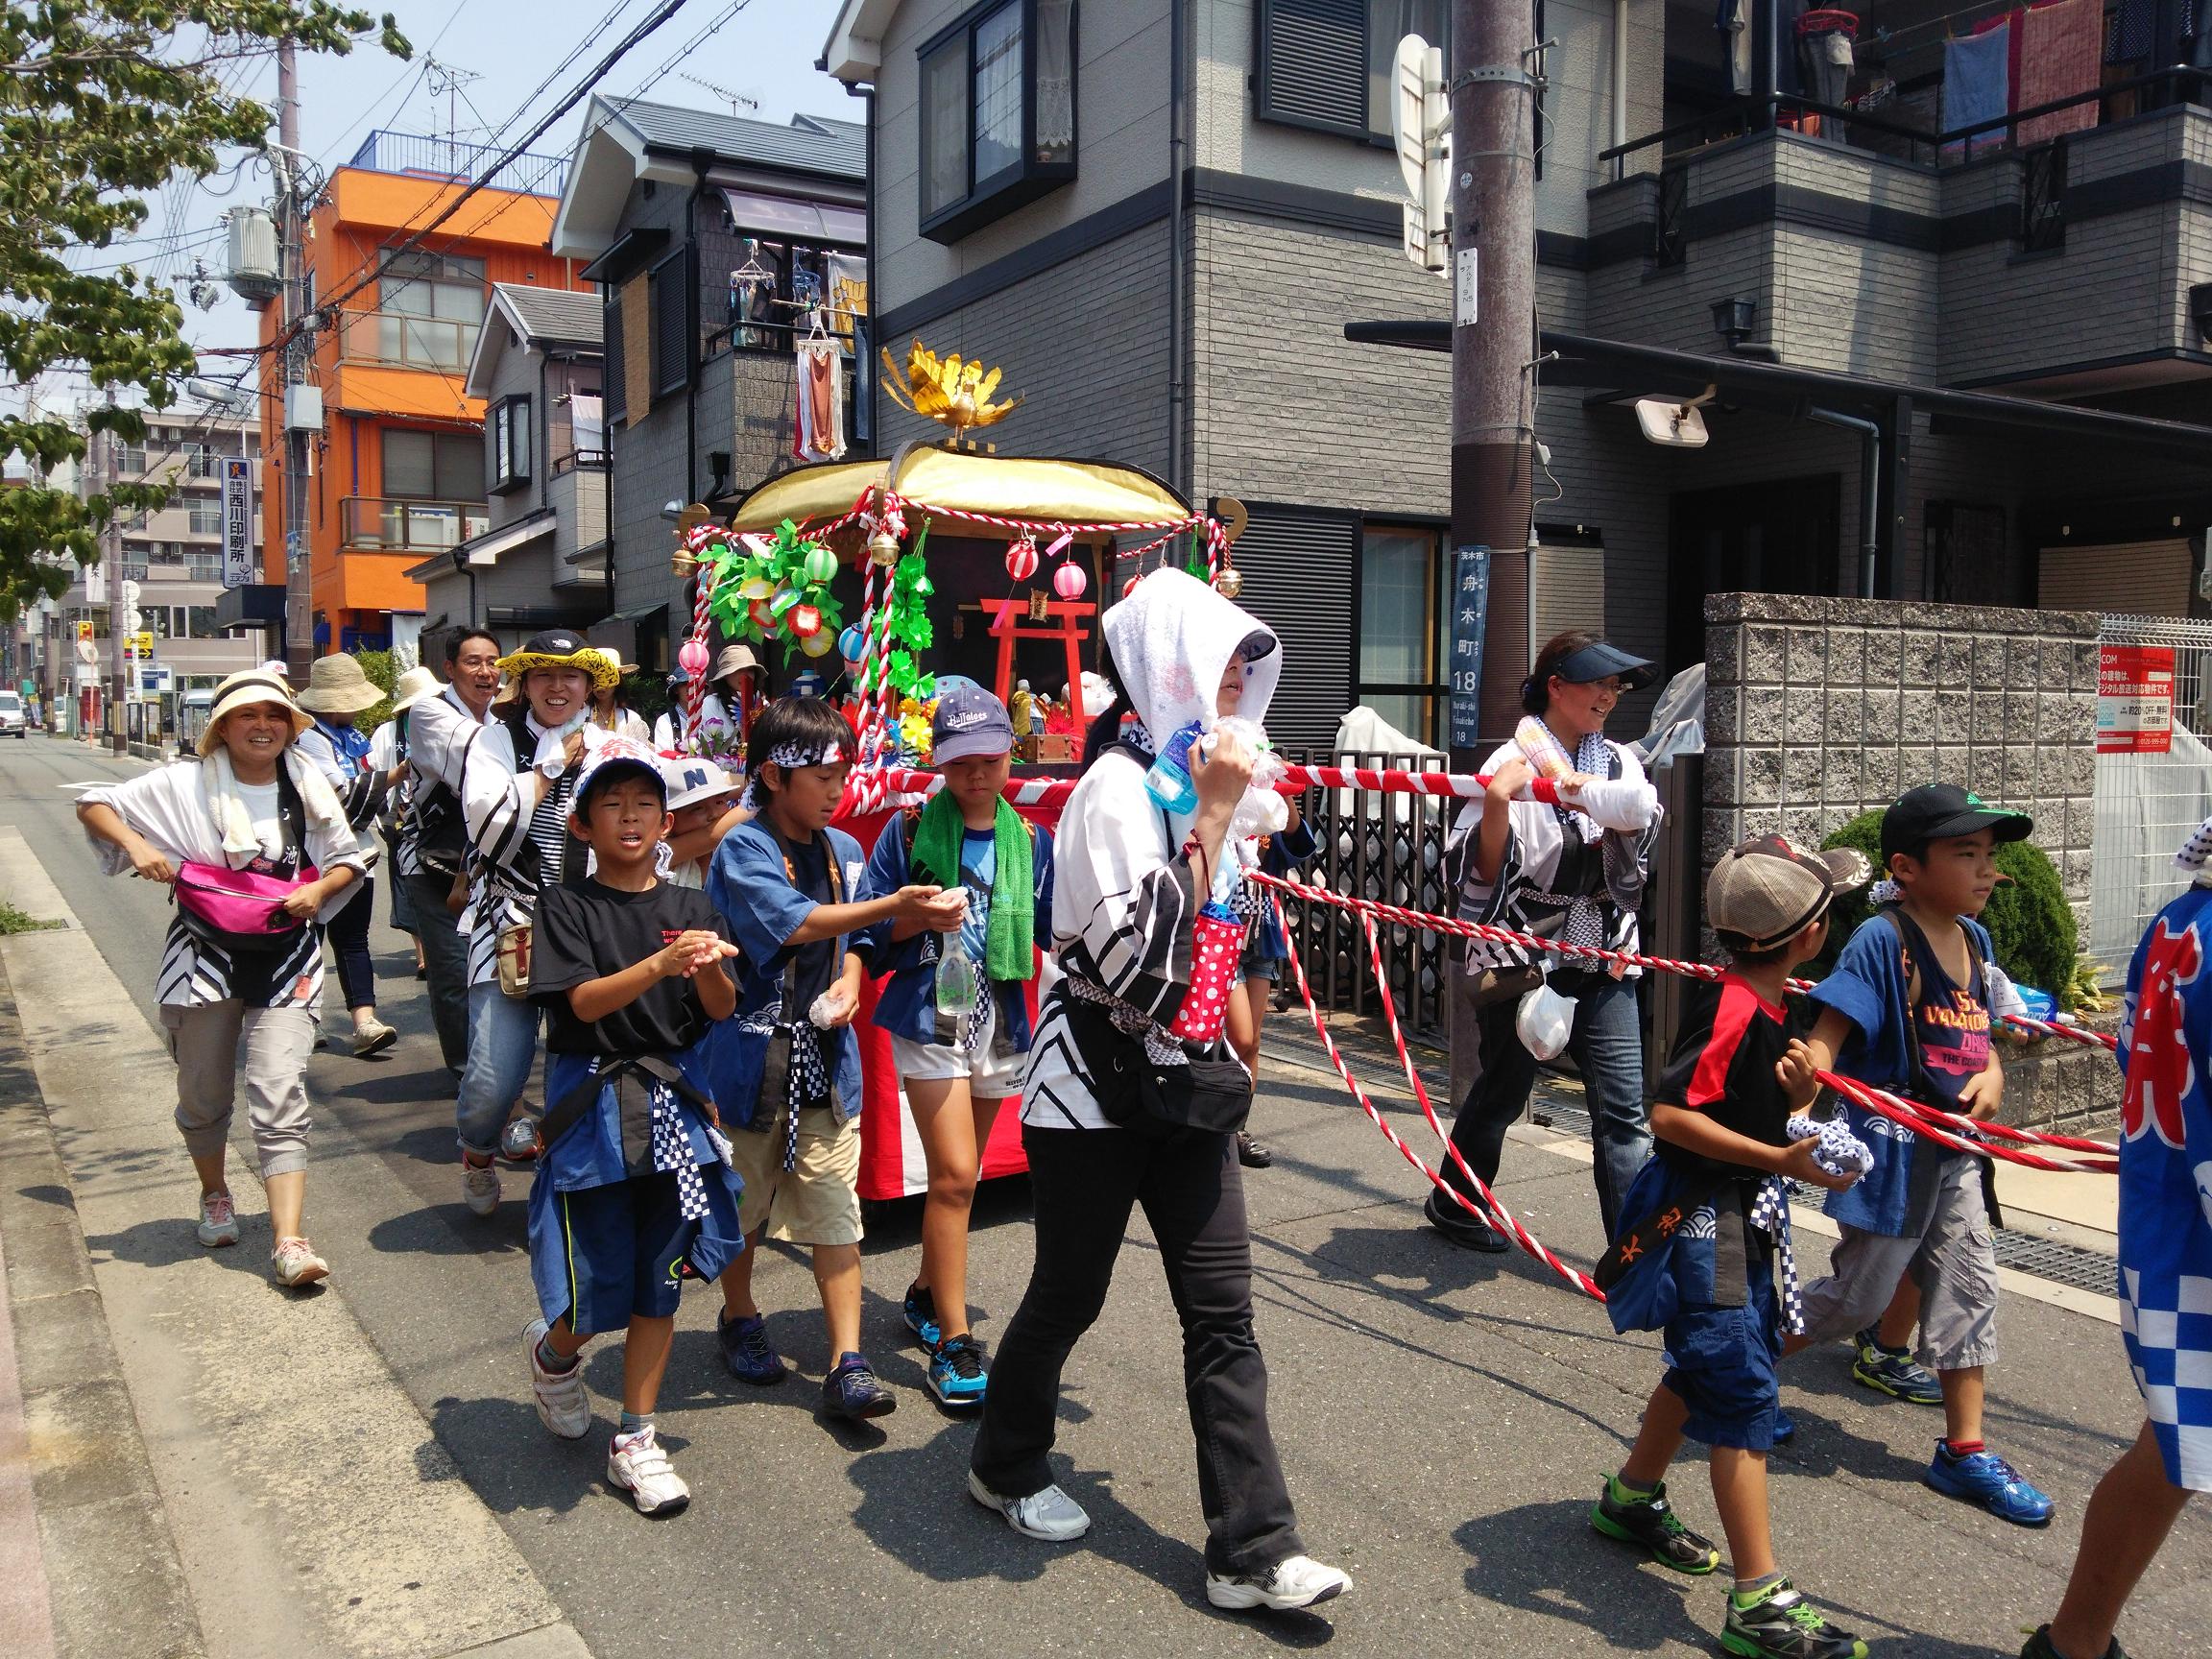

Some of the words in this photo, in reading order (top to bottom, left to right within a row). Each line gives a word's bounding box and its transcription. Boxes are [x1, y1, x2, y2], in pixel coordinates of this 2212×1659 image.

[228, 493, 245, 564] 西川印刷所
[1461, 551, 1485, 561] 茨木市
[1458, 575, 1479, 657] 舟木町
[79, 624, 90, 636] P
[1454, 670, 1476, 691] 18
[2100, 670, 2129, 682] の建物は、
[947, 712, 988, 727] Buffaloes
[1457, 731, 1466, 742] 18
[684, 768, 709, 791] N
[1943, 1053, 1960, 1065] THE
